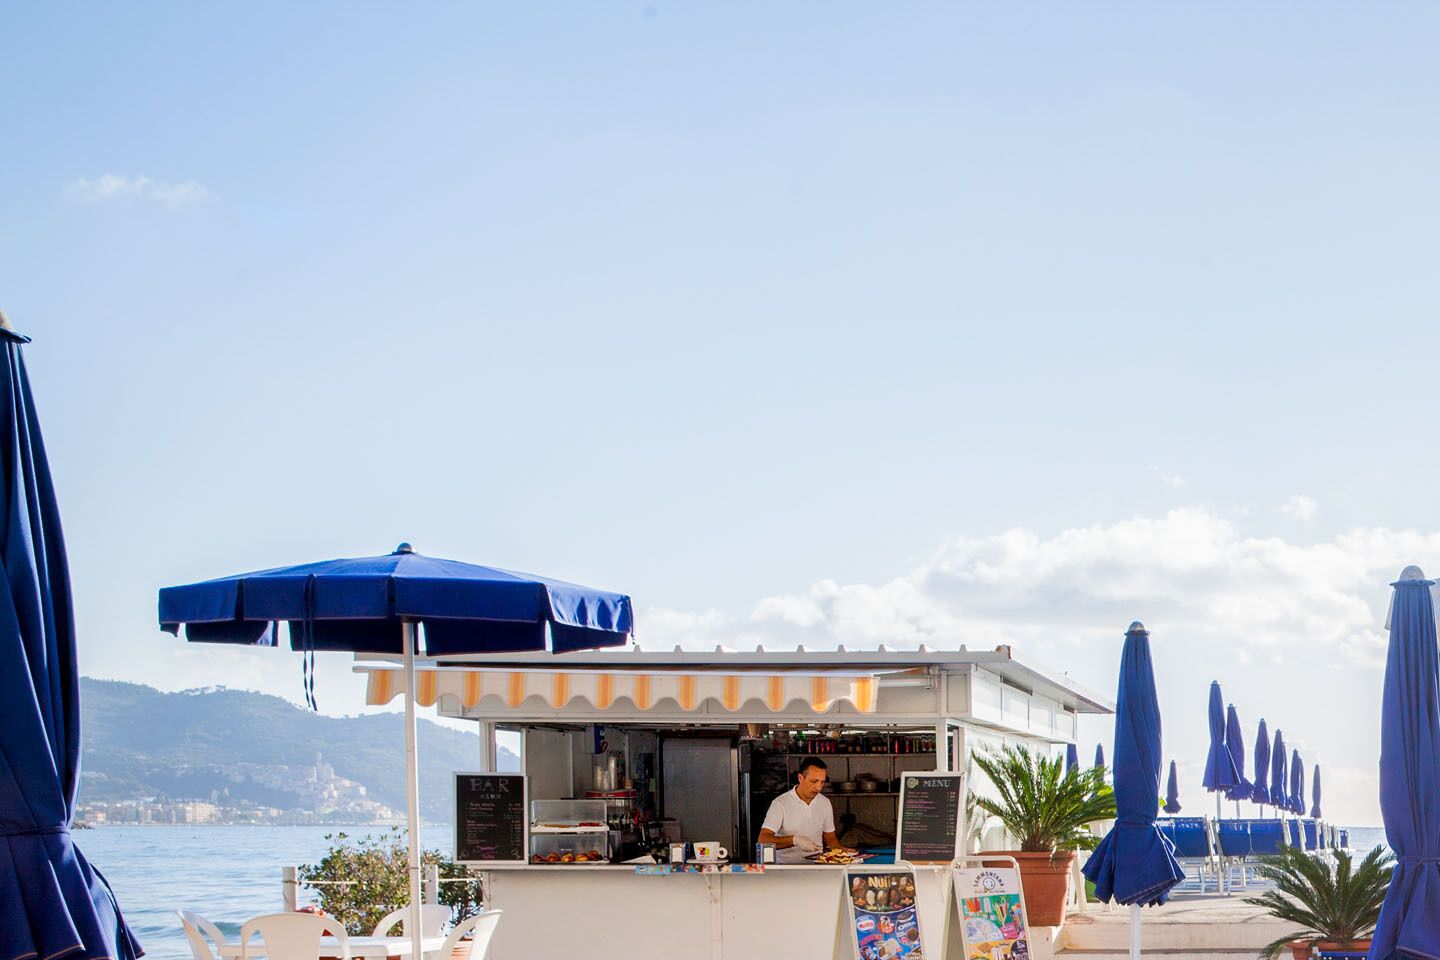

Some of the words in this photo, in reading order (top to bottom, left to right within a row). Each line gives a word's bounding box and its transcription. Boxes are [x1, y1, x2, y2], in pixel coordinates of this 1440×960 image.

[470, 778, 509, 793] BAR
[923, 780, 951, 788] MENU
[973, 871, 1005, 888] SAMMONTANA
